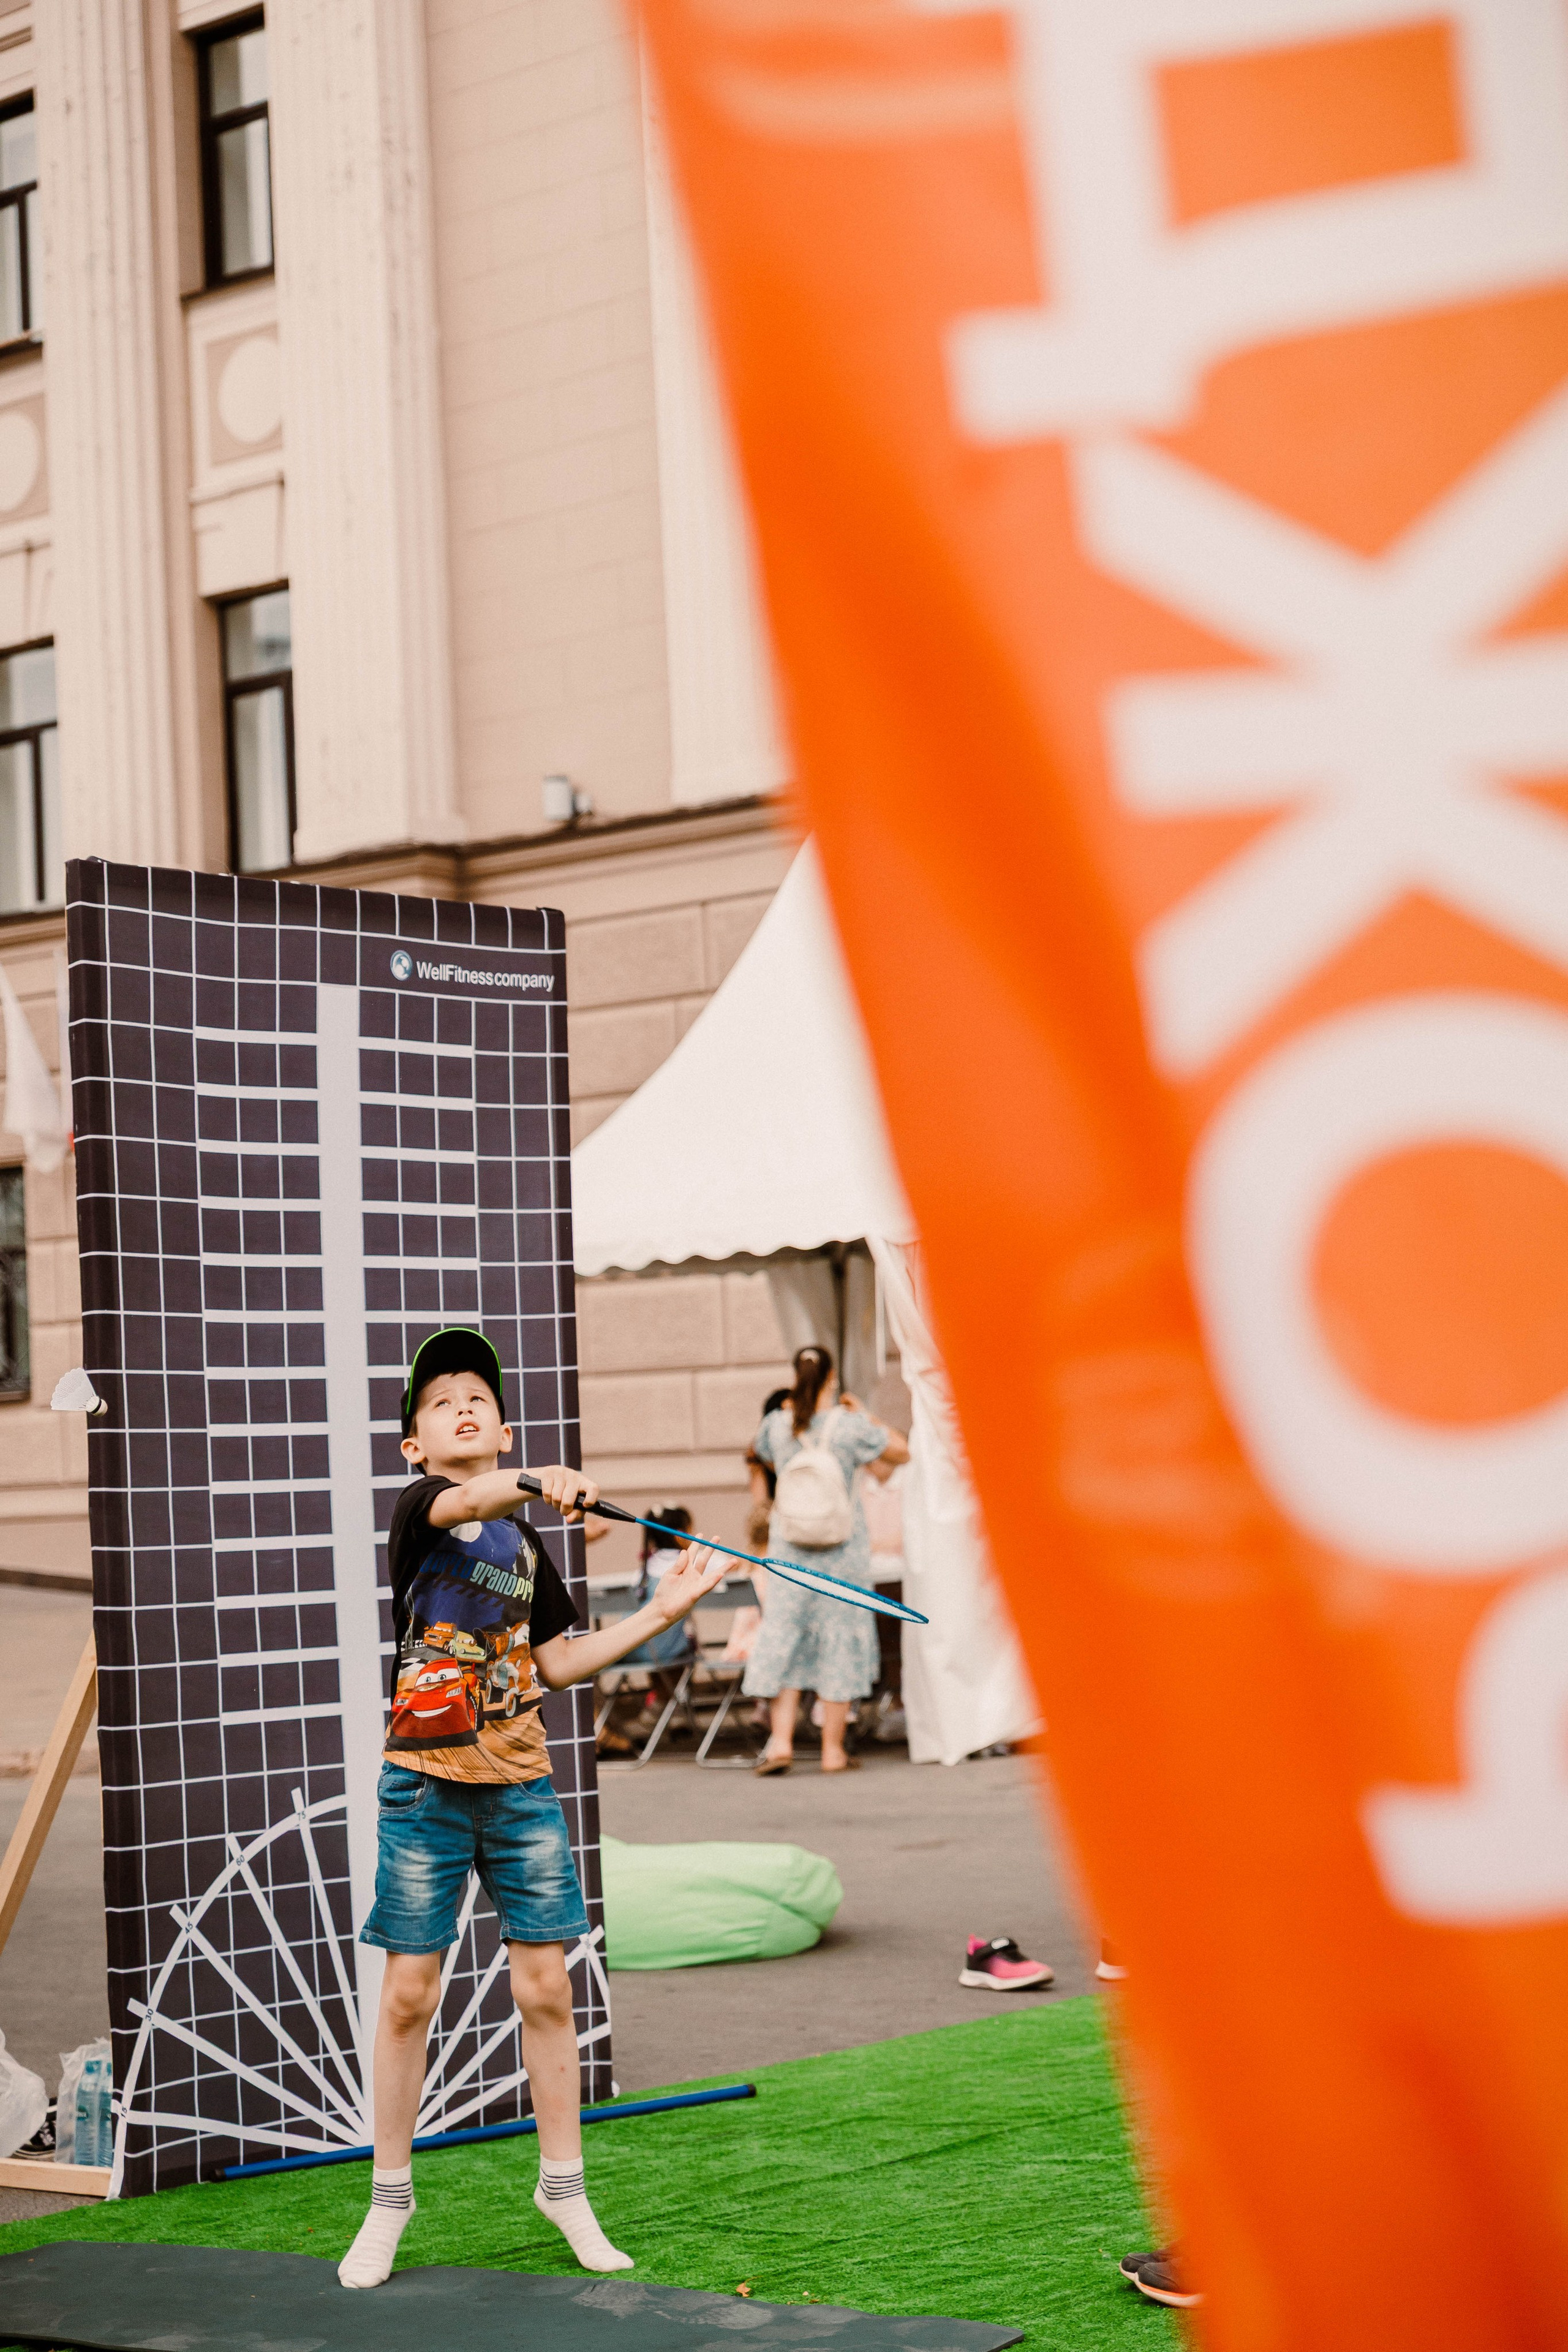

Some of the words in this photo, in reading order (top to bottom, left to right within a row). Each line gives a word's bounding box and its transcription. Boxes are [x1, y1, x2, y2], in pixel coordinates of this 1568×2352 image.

[297, 1811, 306, 1821] 75
[236, 1855, 245, 1866] 60
[185, 1921, 194, 1934] 45
[145, 2008, 154, 2021] 30
[120, 2107, 127, 2119] 15
